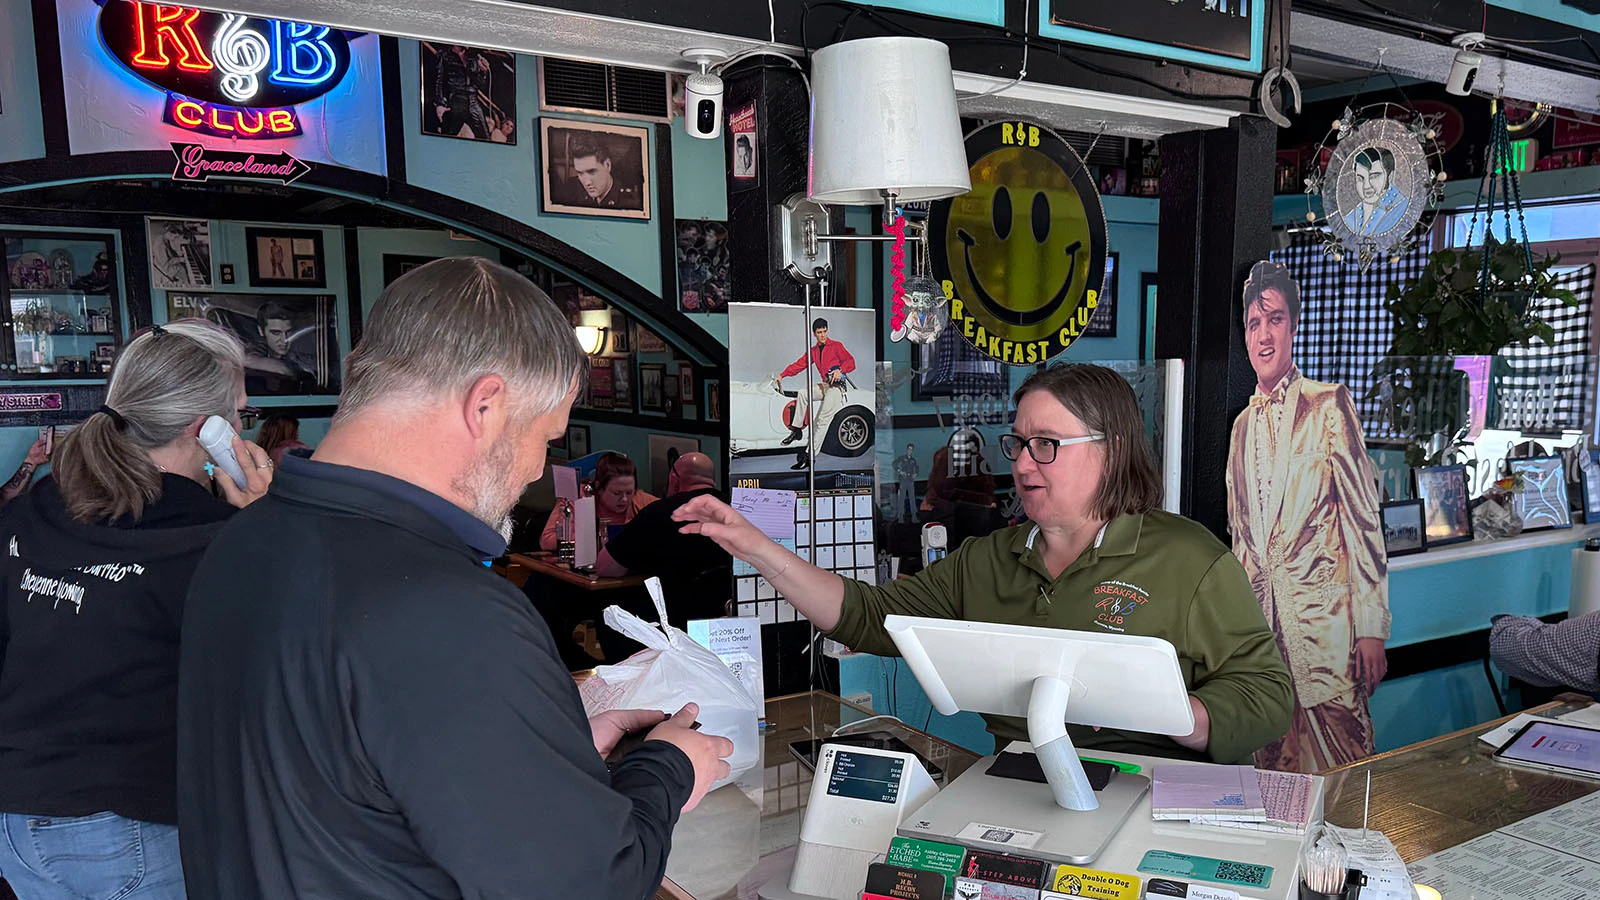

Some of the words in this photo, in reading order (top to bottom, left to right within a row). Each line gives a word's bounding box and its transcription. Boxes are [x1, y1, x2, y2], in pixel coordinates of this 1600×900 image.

[173, 101, 297, 136] CLUB
[732, 116, 756, 132] HOTEL
[181, 145, 297, 178] Graceland
[941, 279, 1050, 364] BREAKFAST
[1058, 289, 1099, 348] CLUB
[8, 396, 43, 406] STREET
[1093, 585, 1149, 606] BREAKFAST
[1097, 613, 1124, 625] CLUB
[719, 628, 733, 636] 20%
[734, 627, 745, 635] Off
[715, 636, 730, 644] Next
[731, 634, 752, 643] Order!
[889, 846, 922, 858] ETCHED
[938, 851, 961, 860] Carpenter
[892, 854, 914, 863] BABE
[982, 870, 1005, 880] STEP
[1007, 874, 1038, 885] ABOVE
[1081, 874, 1107, 884] Double
[1115, 879, 1130, 889] Dog
[889, 889, 922, 900] PROJECTS
[1087, 885, 1120, 898] Training
[1191, 890, 1213, 900] Morgan
